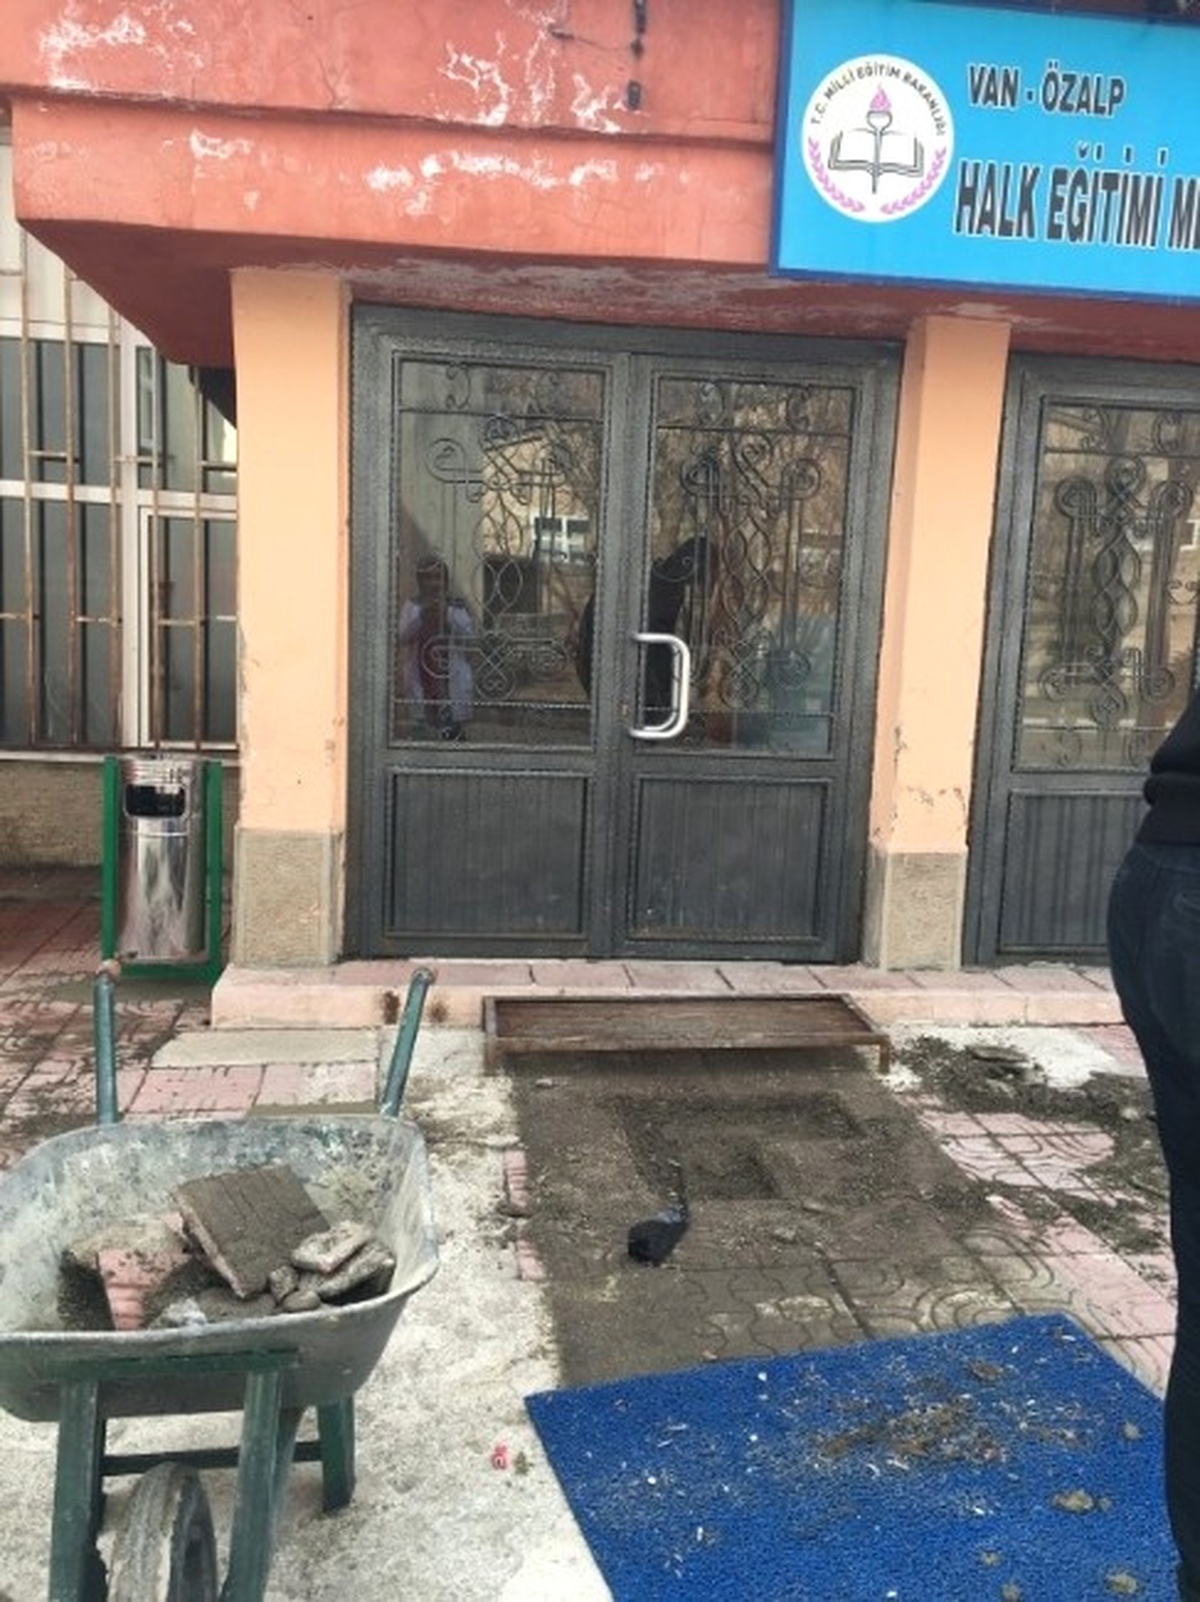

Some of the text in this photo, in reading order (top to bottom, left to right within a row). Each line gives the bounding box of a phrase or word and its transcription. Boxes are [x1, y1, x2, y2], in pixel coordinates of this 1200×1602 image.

[823, 68, 856, 100] MİLLİ
[856, 62, 901, 79] EĞİTİM
[969, 65, 1018, 109] VAN
[1042, 61, 1125, 116] ÖZALP
[955, 160, 1041, 238] HALK
[1046, 141, 1169, 248] EĞİTİMİ
